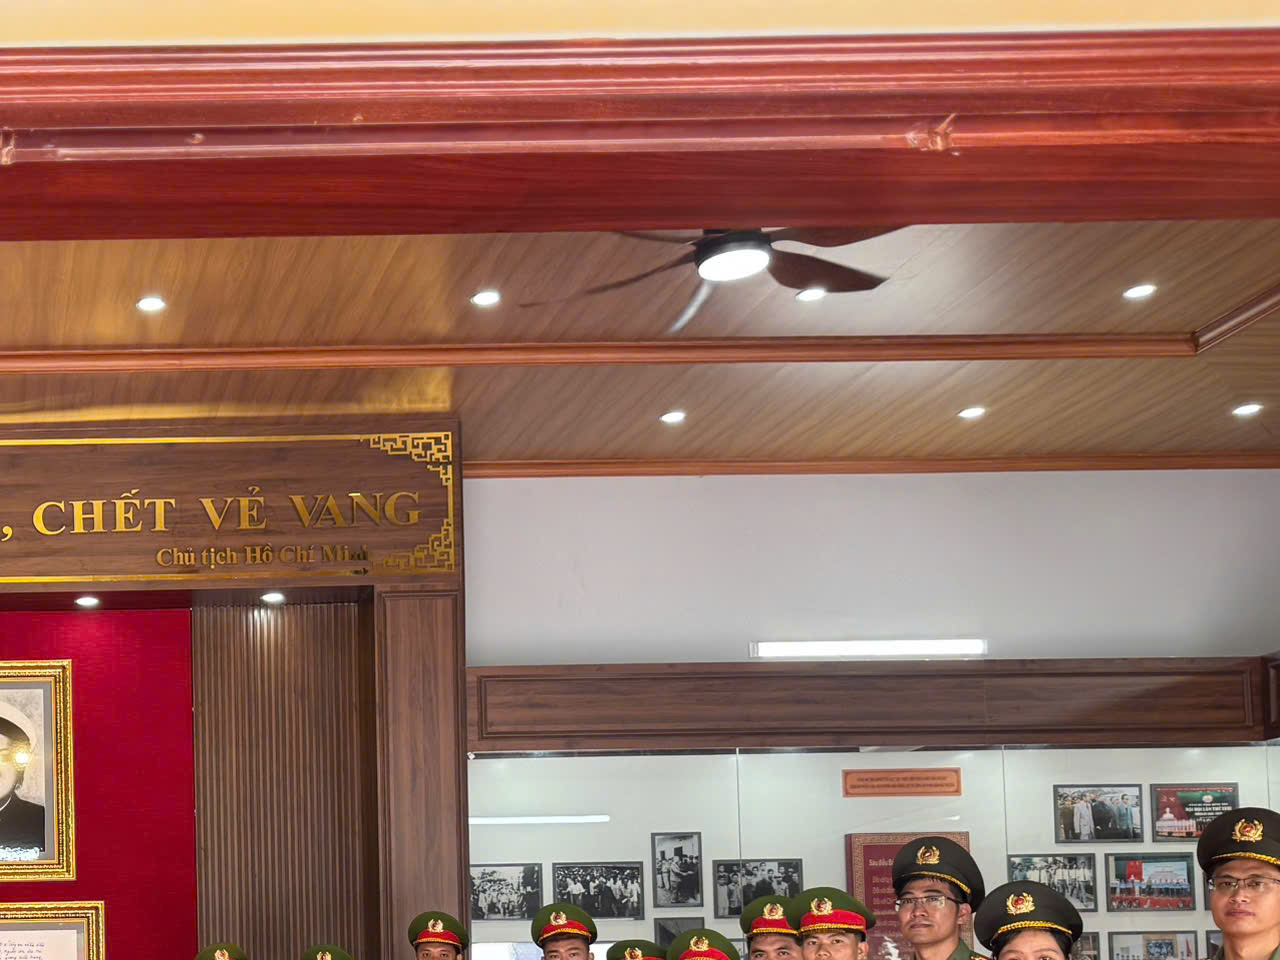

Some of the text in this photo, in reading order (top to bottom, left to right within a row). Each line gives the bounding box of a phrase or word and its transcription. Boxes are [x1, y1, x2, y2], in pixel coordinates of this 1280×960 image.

[32, 488, 176, 536] CHẾT
[199, 486, 268, 530] VẺ
[288, 491, 422, 528] VANG
[156, 547, 195, 567] Chủ
[201, 547, 238, 569] tịch
[244, 542, 273, 565] Hồ
[279, 544, 315, 563] Chí
